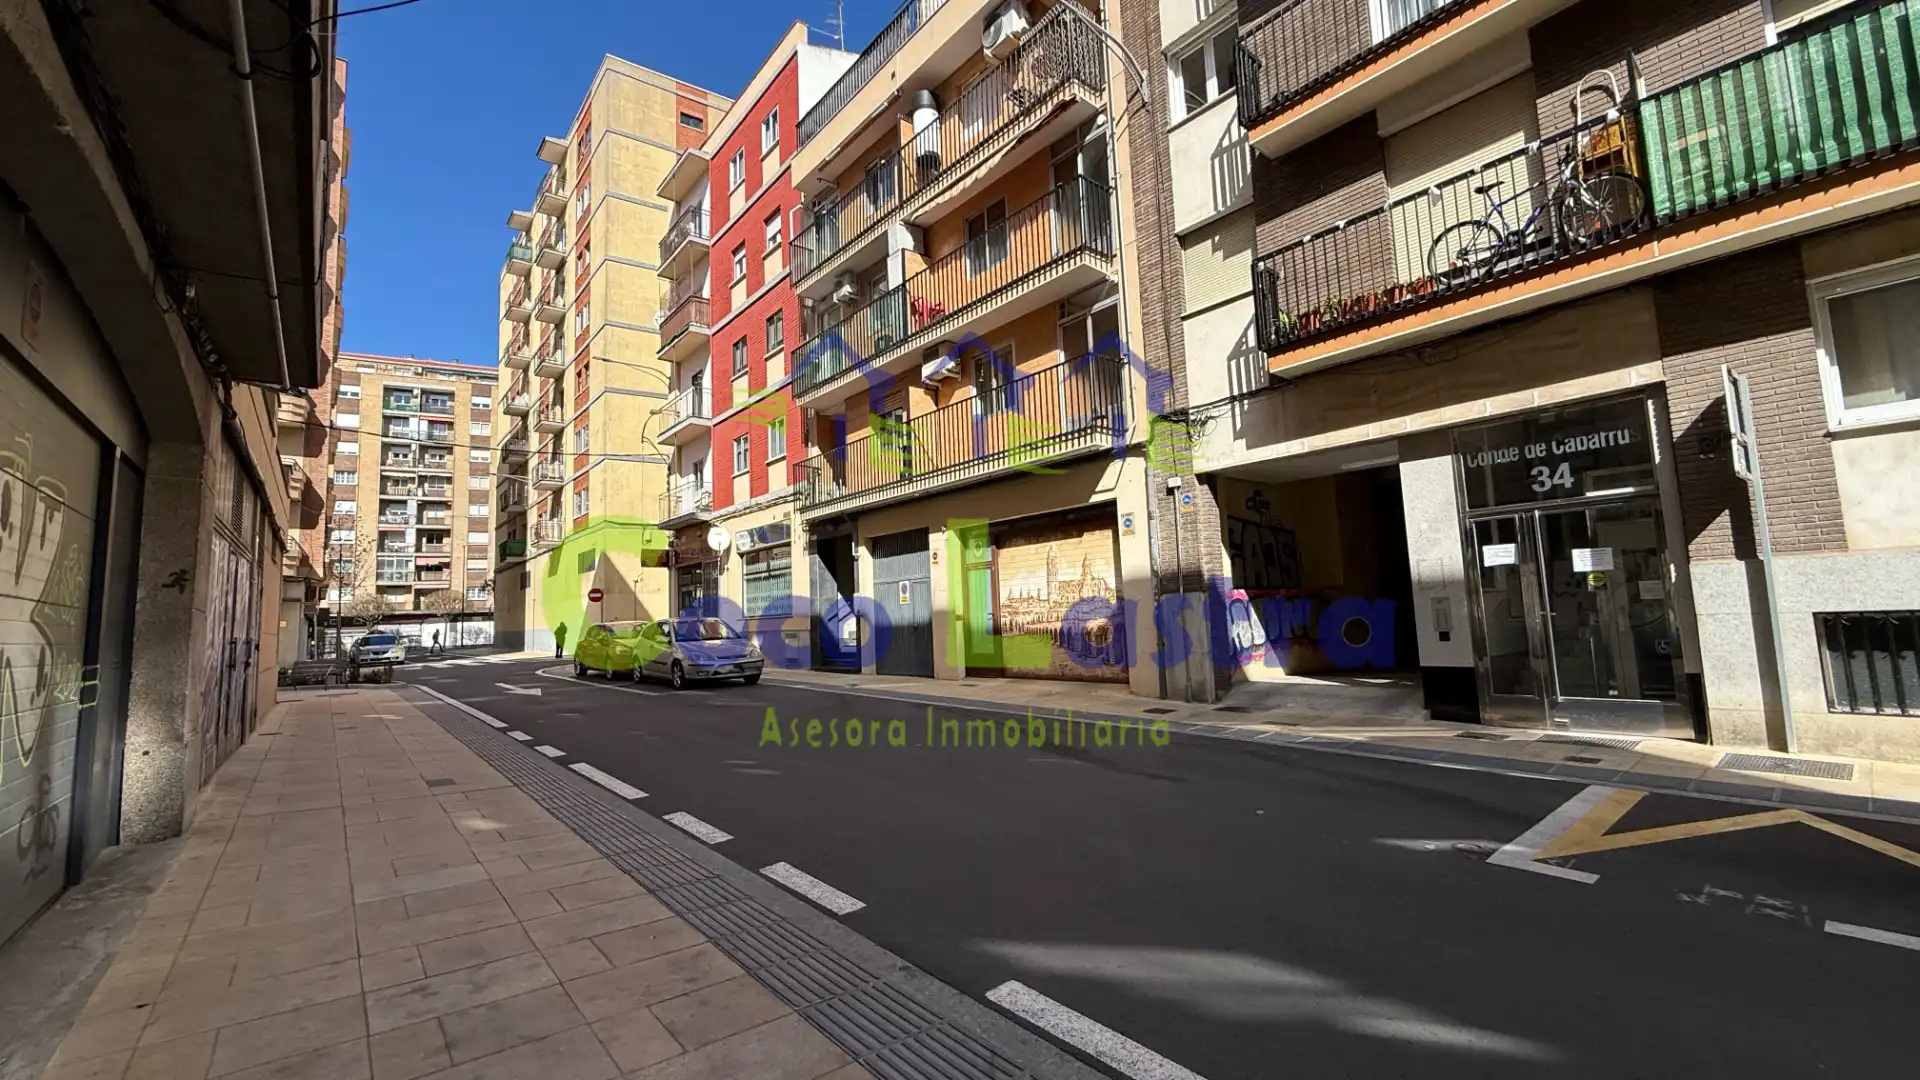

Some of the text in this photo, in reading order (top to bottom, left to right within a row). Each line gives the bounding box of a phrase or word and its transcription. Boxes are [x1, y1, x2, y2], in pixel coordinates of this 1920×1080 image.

[1466, 427, 1642, 468] Conde de Cabarrus
[1530, 461, 1575, 493] 34
